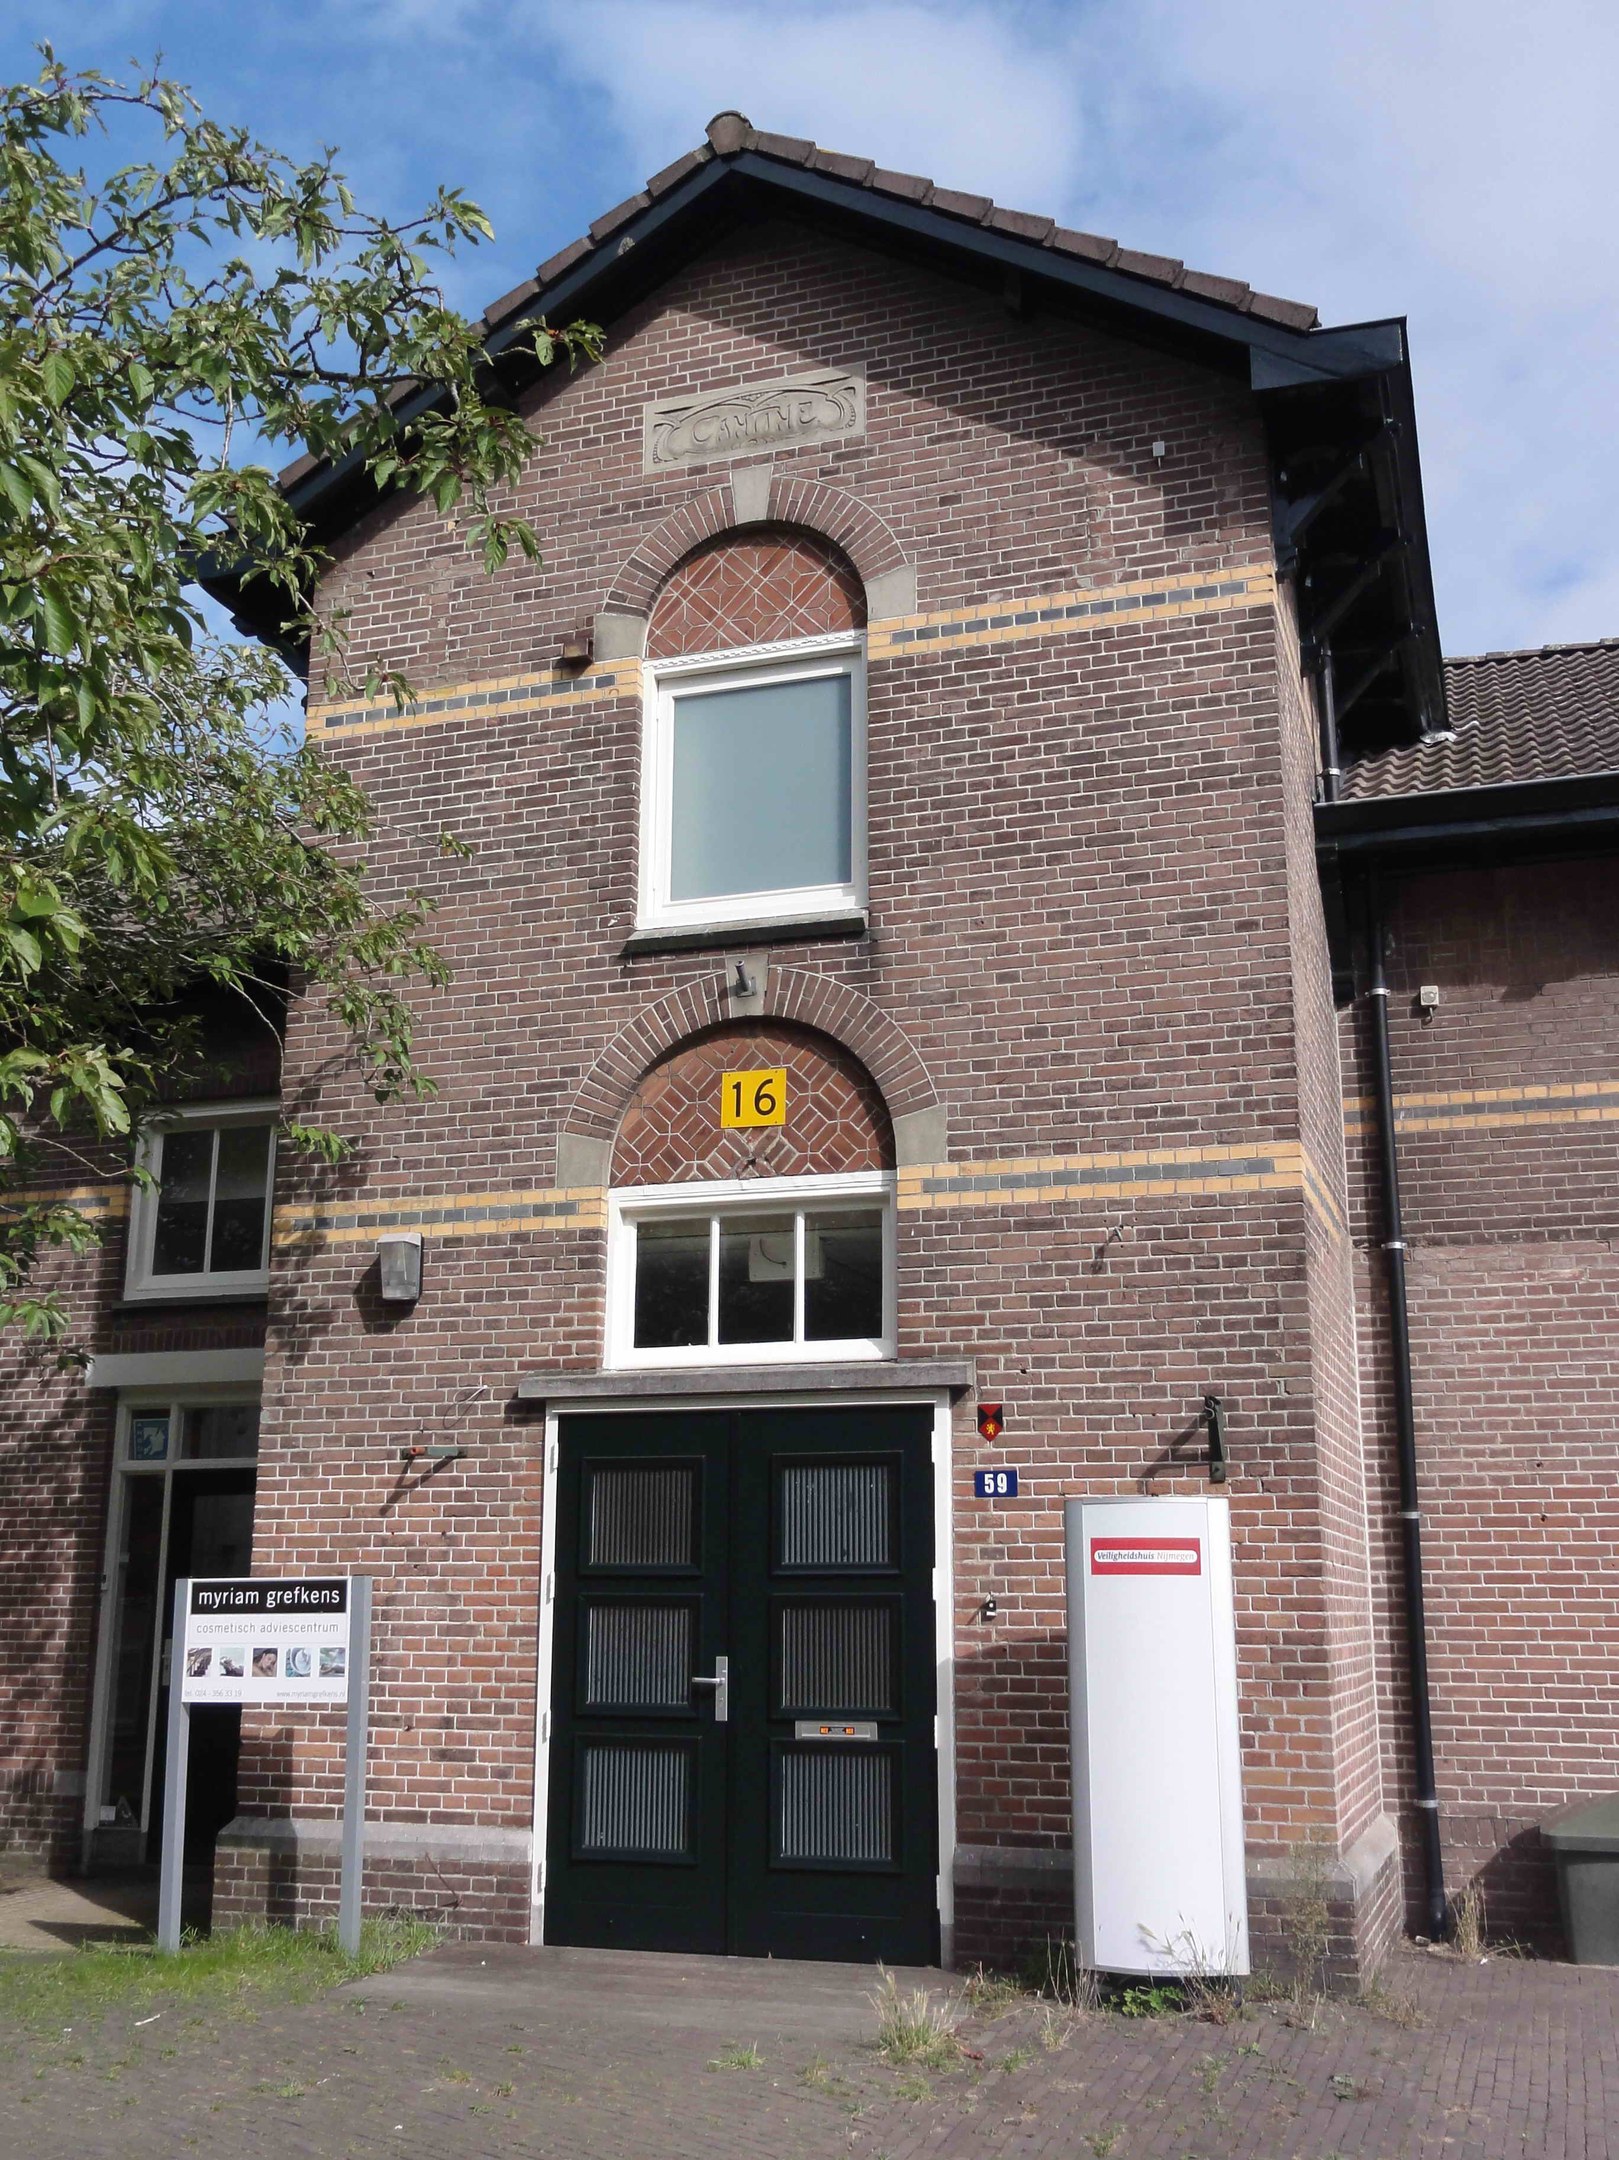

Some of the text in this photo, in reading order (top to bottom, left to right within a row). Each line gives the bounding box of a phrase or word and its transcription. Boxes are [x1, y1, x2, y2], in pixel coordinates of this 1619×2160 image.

[732, 1078, 777, 1118] 16
[984, 1472, 1008, 1494] 59
[1097, 1551, 1195, 1562] Veiligheidshuis Nijmegen
[198, 1586, 340, 1609] myriam grefkens
[196, 1622, 339, 1634] cosmetisch adviescentrum
